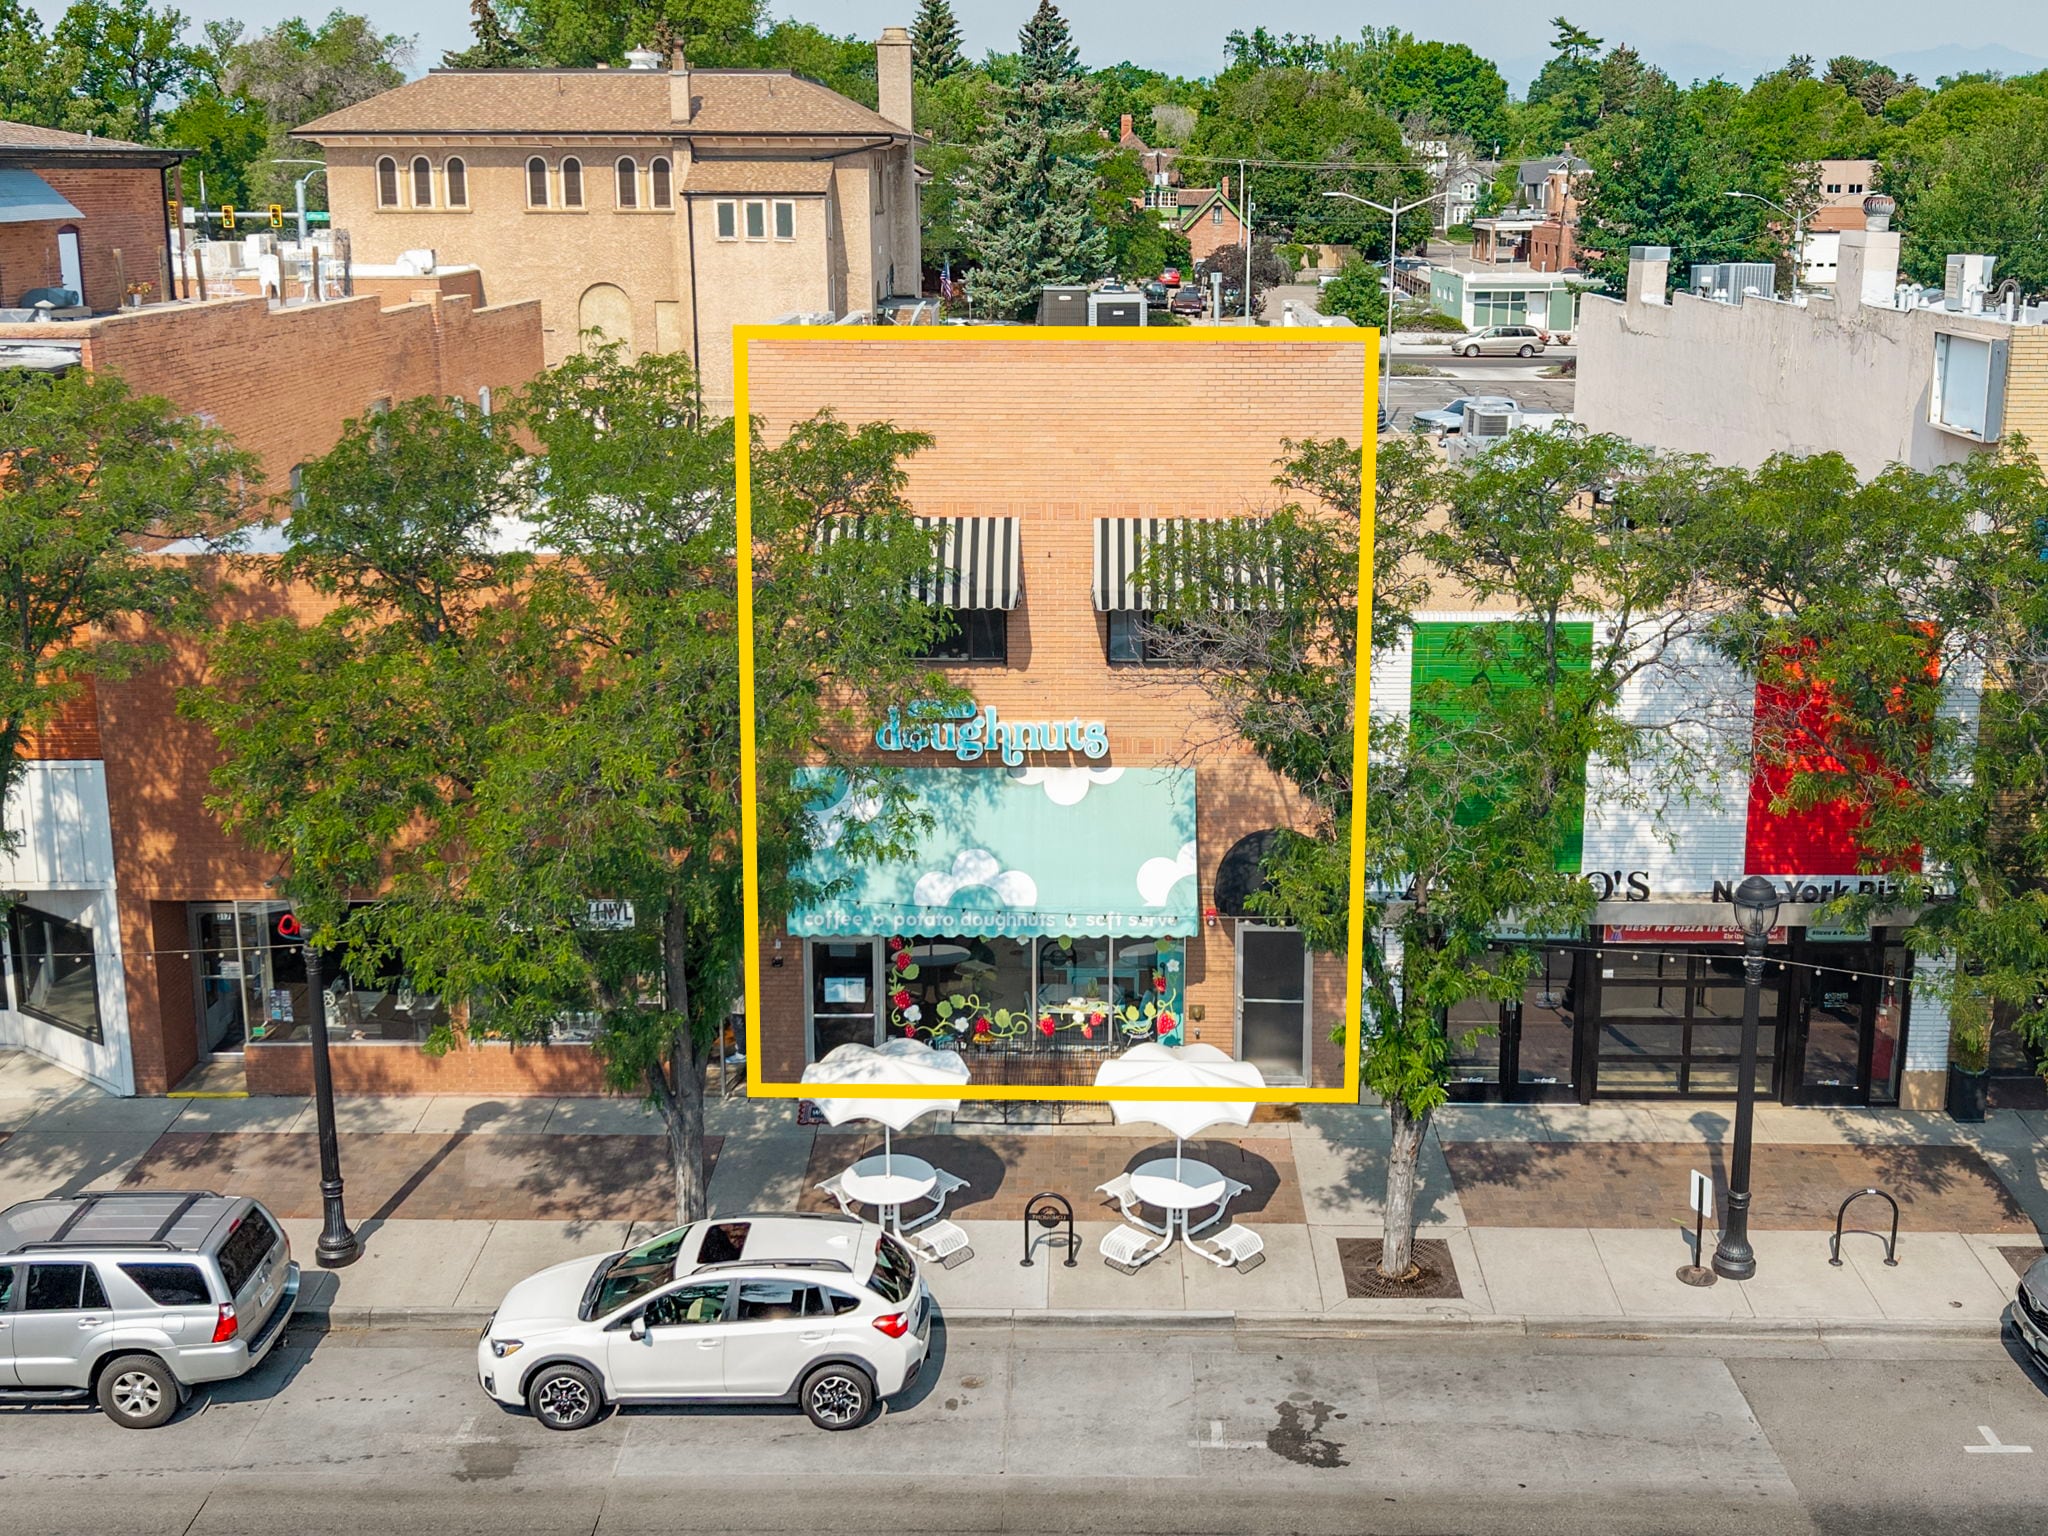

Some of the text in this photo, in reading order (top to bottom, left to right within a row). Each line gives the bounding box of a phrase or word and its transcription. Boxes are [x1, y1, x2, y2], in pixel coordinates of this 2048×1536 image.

[875, 705, 1109, 766] doughnuts
[1785, 880, 1849, 902] York
[804, 910, 1177, 931] coffee potato doughnuts soft serve
